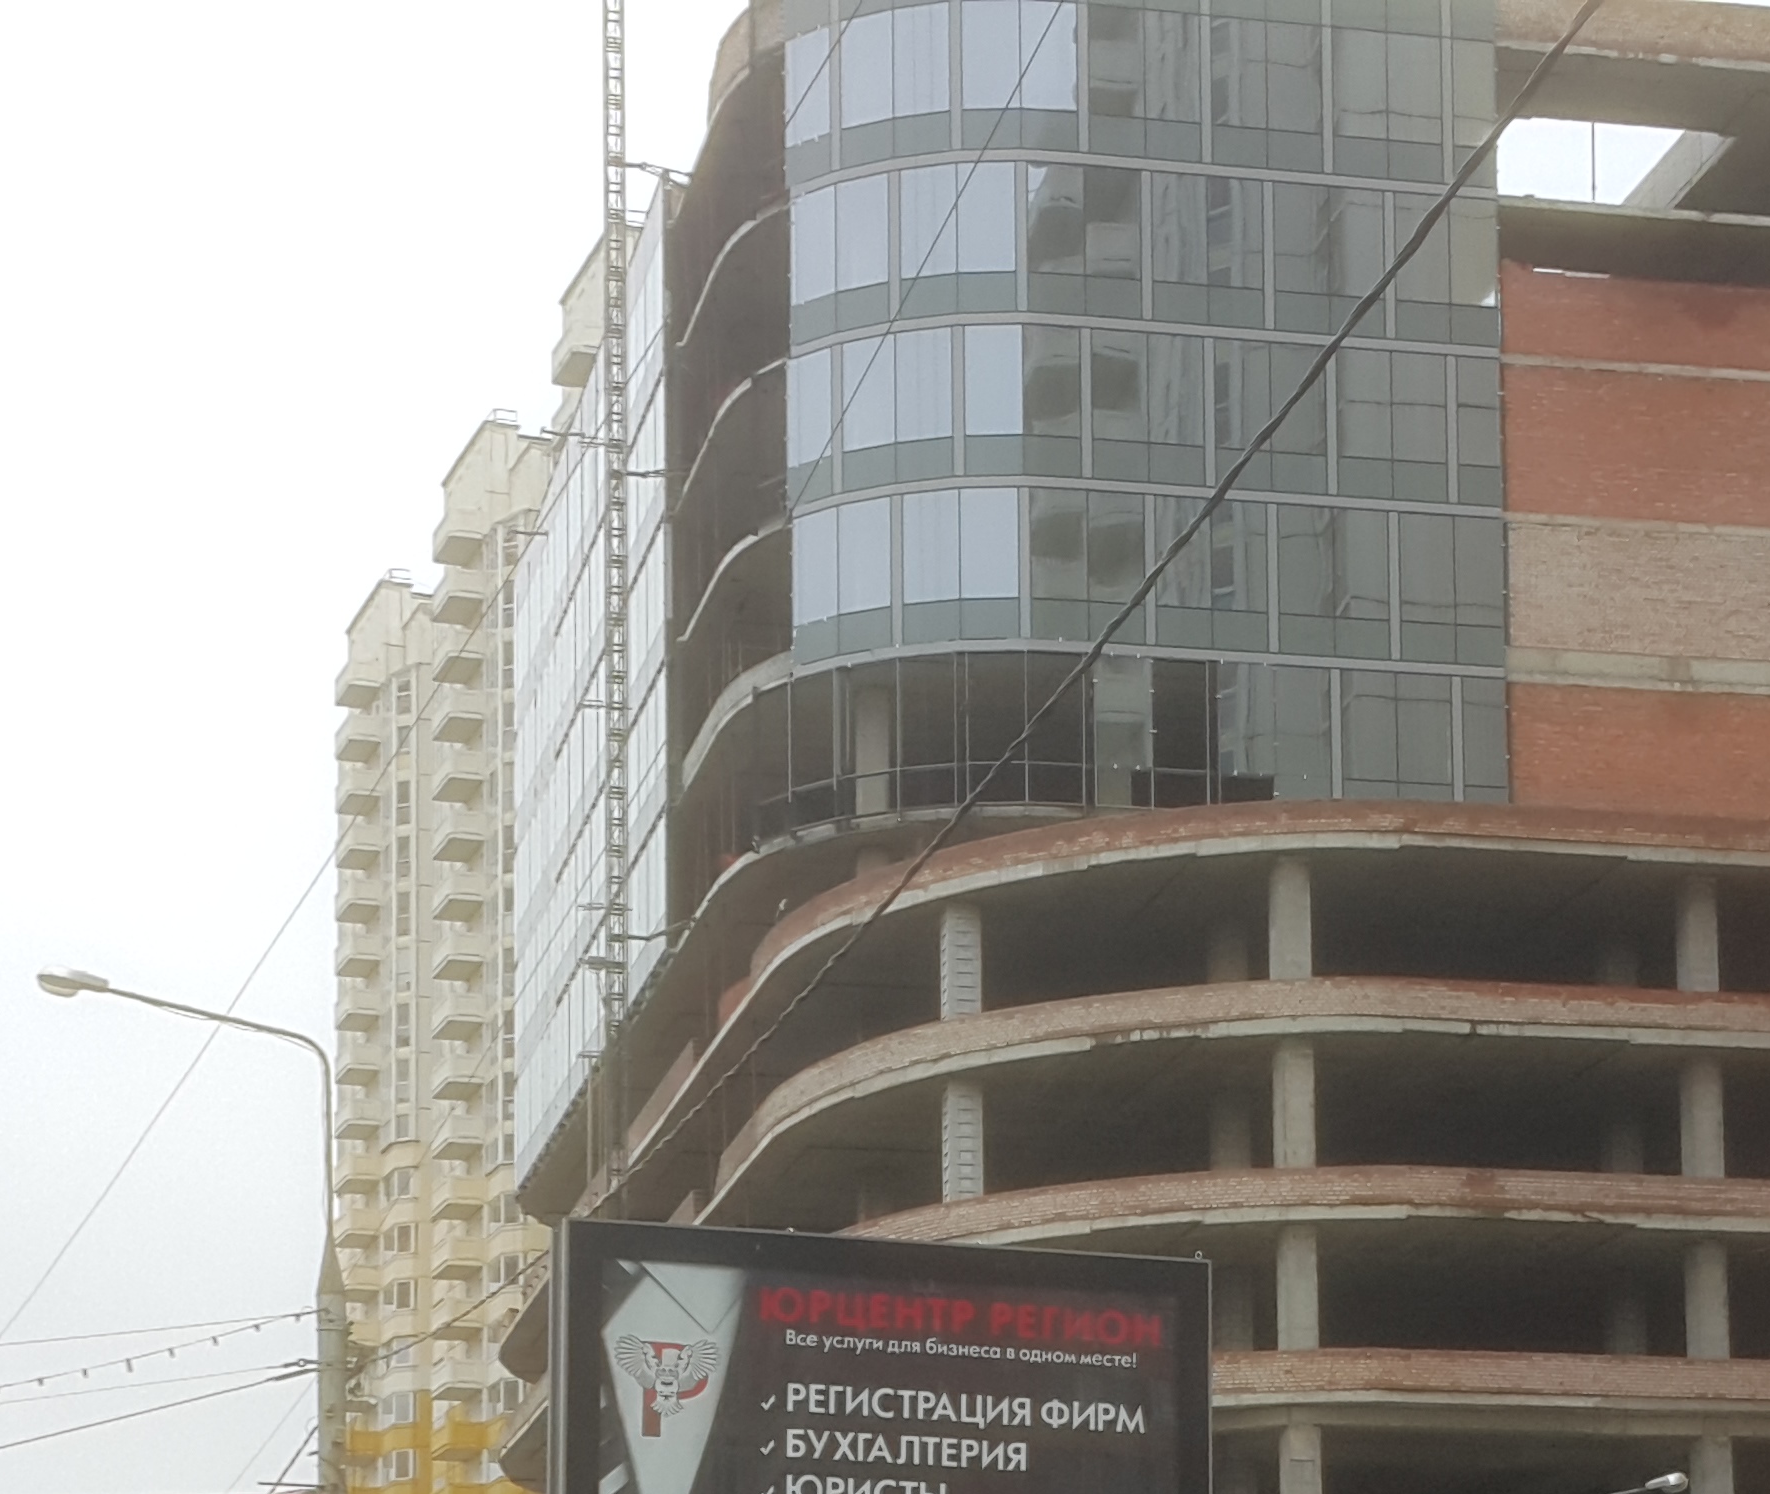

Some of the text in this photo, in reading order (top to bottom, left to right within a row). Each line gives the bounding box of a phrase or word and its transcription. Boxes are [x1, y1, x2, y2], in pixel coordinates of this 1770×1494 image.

[758, 1286, 1163, 1346] ЮРЦЕНТР РЕГИОН
[785, 1329, 1137, 1368] Все услуги для бизнеса в одном месте!
[786, 1382, 1146, 1434] РЕГИСТРАЦИЯ ФИРМ
[785, 1428, 1028, 1472] БУХГАЛТЕРИЯ
